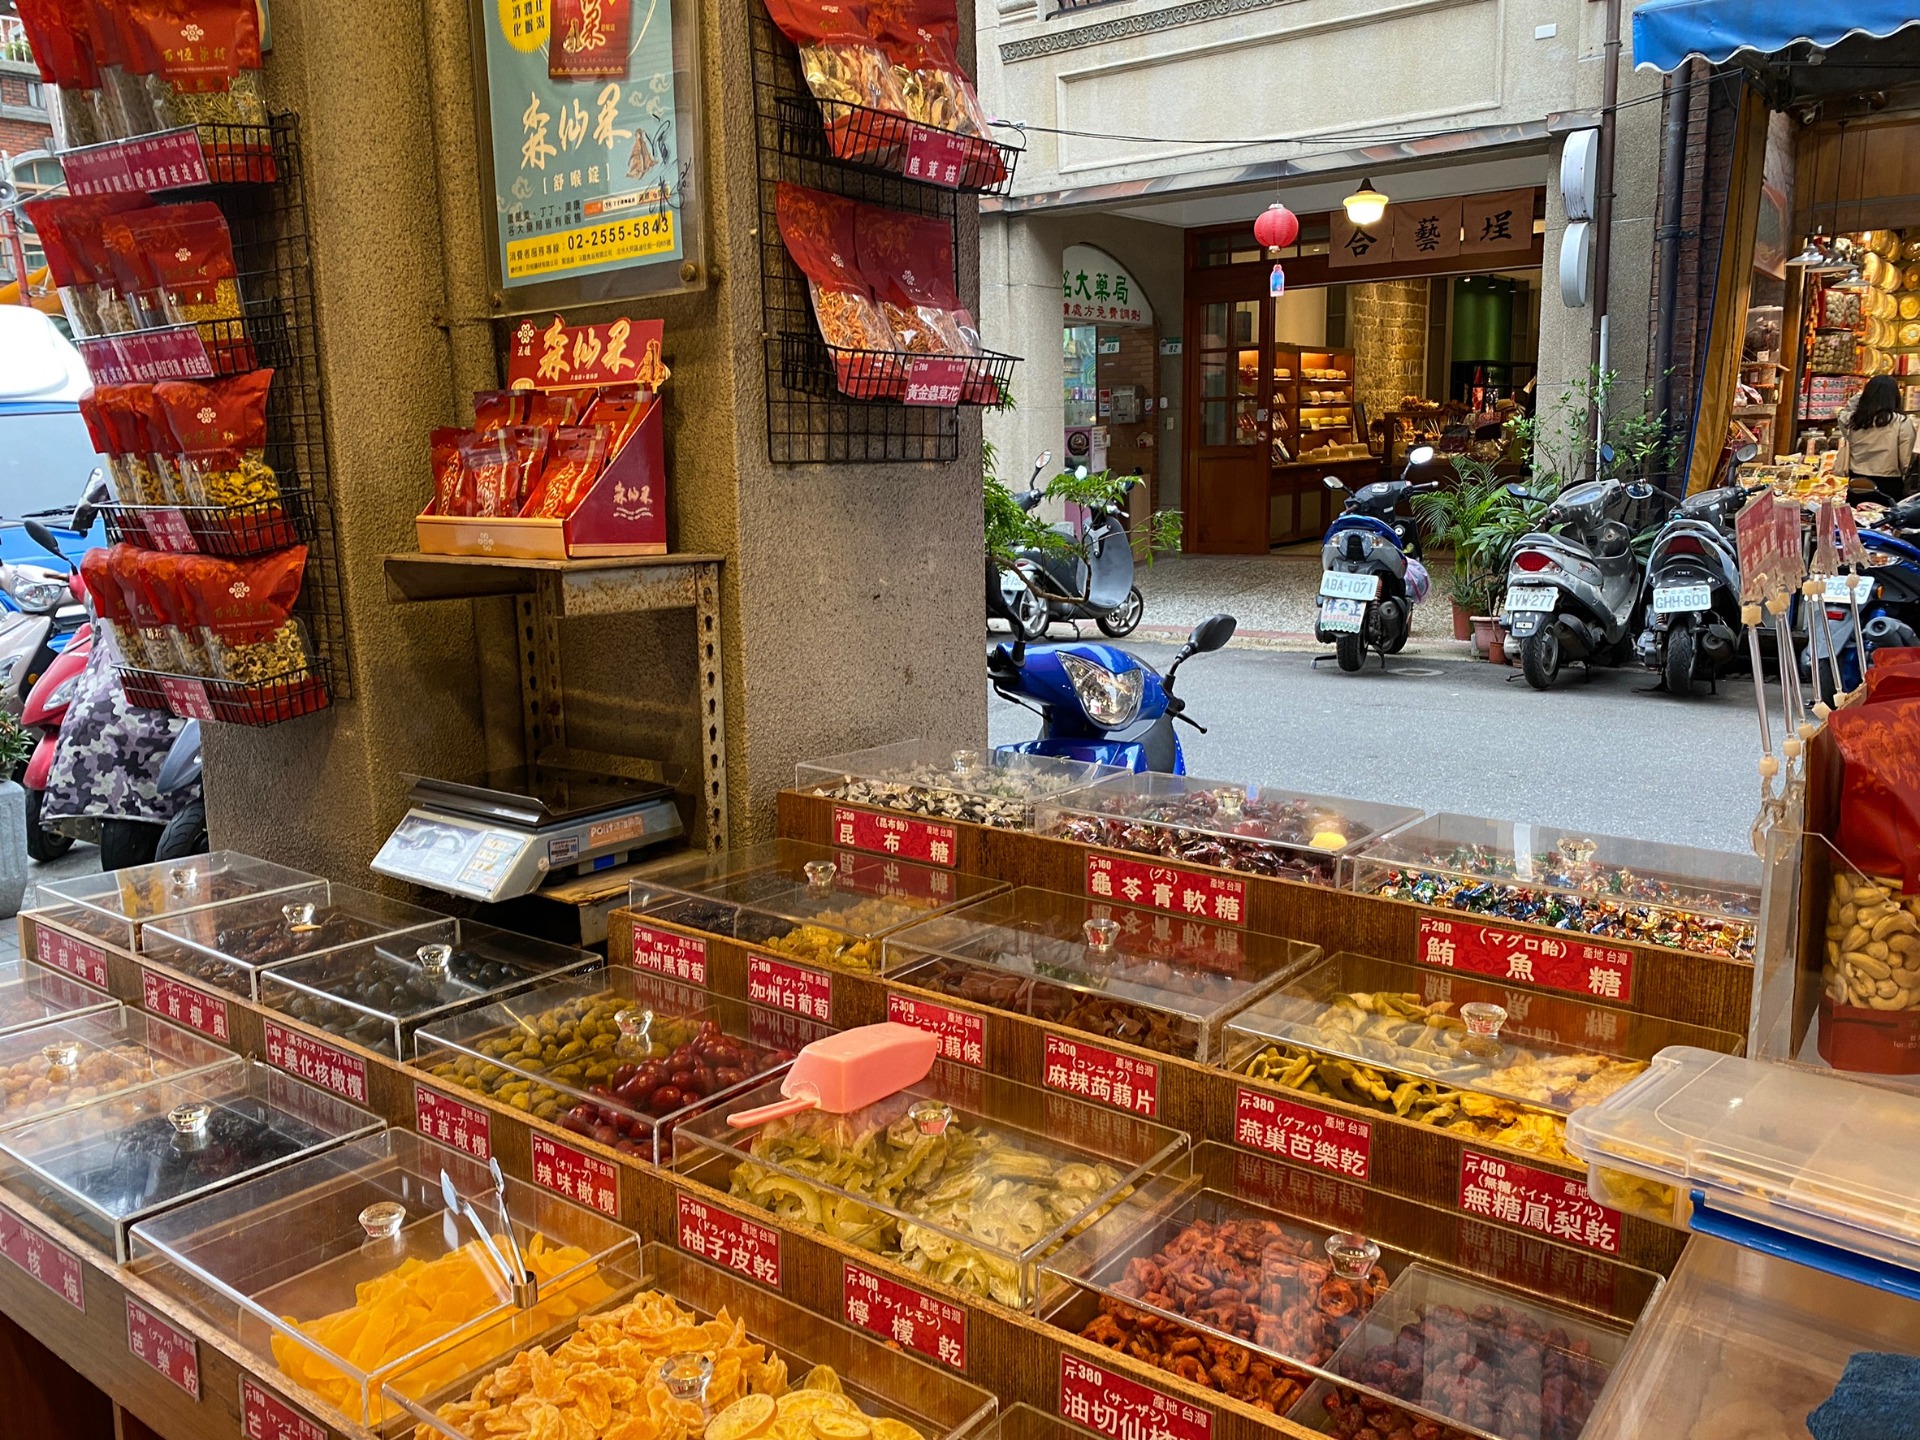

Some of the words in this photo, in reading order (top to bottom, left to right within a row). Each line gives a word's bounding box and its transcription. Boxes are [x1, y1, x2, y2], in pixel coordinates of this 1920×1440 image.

[568, 217, 669, 250] 02-2555-5843
[840, 823, 949, 863] 昆布糖
[1091, 871, 1240, 922] 龜苓膏軟糖
[1432, 920, 1451, 934] 280
[1479, 928, 1567, 959] (マグロ飴)
[41, 940, 105, 985] 甘甜梅肉
[635, 947, 704, 982] 加州黑葡萄
[1426, 936, 1622, 998] 鮪魚糖
[1583, 947, 1604, 961] 產地
[1606, 950, 1628, 966] 台灣
[750, 980, 829, 1019] 加州白葡萄
[899, 1001, 914, 1013] 300
[1058, 1042, 1076, 1056] 300
[269, 1041, 363, 1101] 中藥化核橄欖
[1047, 1064, 1155, 1114] 麻辣蒟蒻片
[1253, 1096, 1275, 1113] 380
[420, 1112, 487, 1159] 甘草橄欖
[1325, 1116, 1345, 1132] 產地
[1348, 1122, 1368, 1138] 台灣
[1239, 1117, 1366, 1177] 燕巢芭樂乾
[537, 1161, 615, 1215] 辣味橄欖
[1480, 1160, 1506, 1178] 480
[690, 1203, 707, 1220] 380
[1464, 1183, 1615, 1251] 無糖鳳梨乾
[683, 1225, 777, 1285] 柚子皮乾
[859, 1273, 878, 1291] 380
[868, 1289, 941, 1331] (ドライレモン)
[848, 1296, 961, 1367] 檸檬乾
[131, 1330, 197, 1394] 芭樂乾
[1078, 1365, 1102, 1386] 380
[1153, 1394, 1178, 1416] 產地
[1182, 1406, 1207, 1428] 台灣
